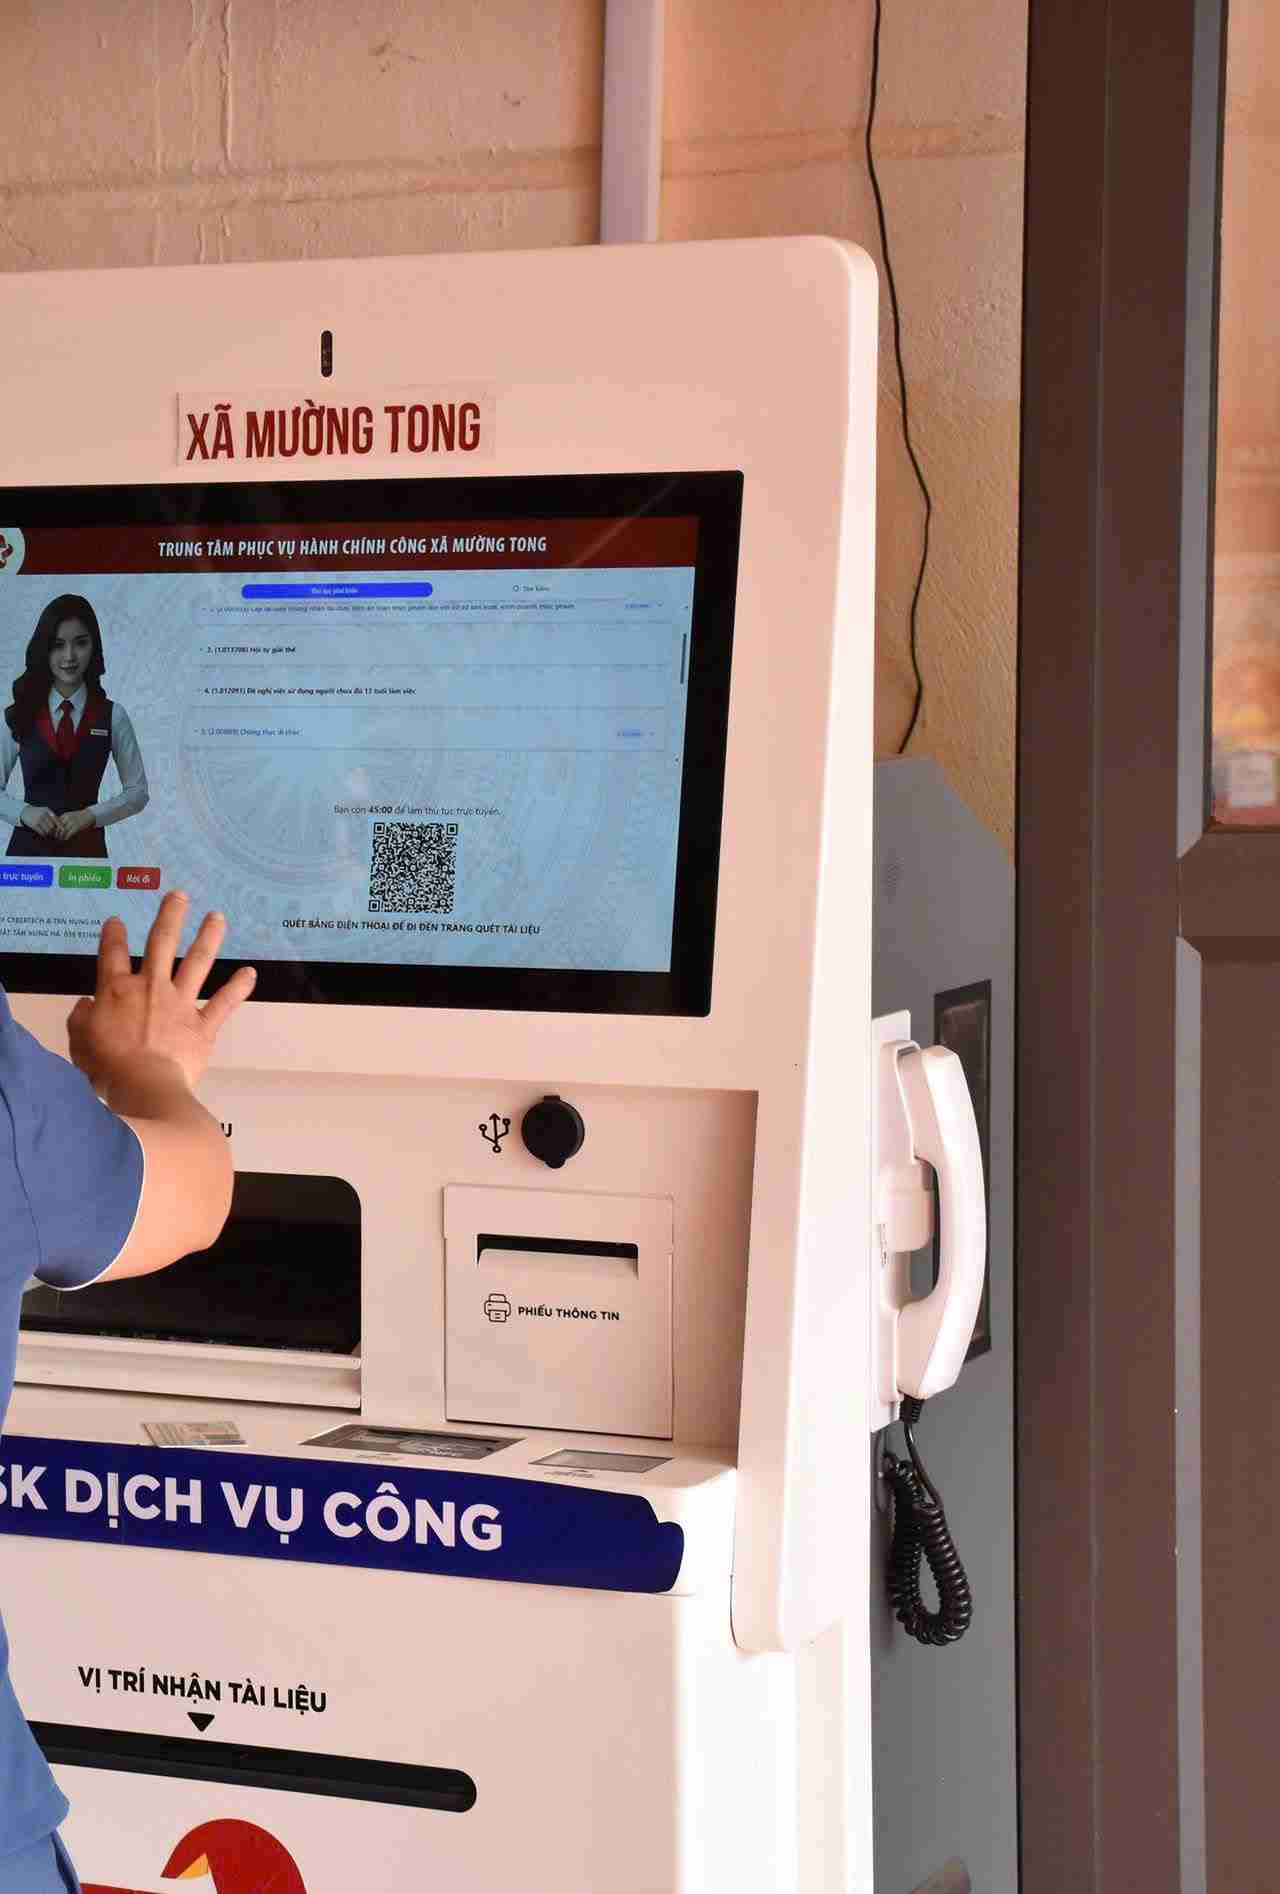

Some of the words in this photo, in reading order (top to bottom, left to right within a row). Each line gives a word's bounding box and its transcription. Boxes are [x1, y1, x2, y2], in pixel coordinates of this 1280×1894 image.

[186, 403, 235, 461] XÃ
[245, 399, 373, 459] MƯỜNG
[383, 402, 481, 454] TONG
[158, 541, 203, 557] TRUNG
[206, 539, 234, 557] TÂM
[238, 540, 274, 560] PHỤC
[278, 540, 296, 560] VỤ
[300, 537, 338, 556] HÀNH
[342, 537, 385, 555] CHÍNH
[390, 536, 427, 554] CÔNG
[430, 536, 449, 553] XÃ
[452, 535, 505, 553] MƯỜNG
[509, 536, 547, 552] TONG
[369, 806, 392, 814] 45:00
[282, 917, 306, 928] QUÉT
[441, 922, 473, 933] TRANG
[518, 1304, 552, 1317] PHIẾU
[556, 1307, 597, 1320] THÔNG
[600, 1311, 619, 1320] TIN
[65, 1468, 202, 1528] DỊCH
[220, 1481, 303, 1544] VỤ
[324, 1482, 503, 1552] CÔNG
[78, 1666, 101, 1693] VỊ
[108, 1667, 145, 1692] TRÍ
[152, 1672, 221, 1704] NHẬN
[228, 1678, 266, 1706] TÀI
[273, 1684, 327, 1715] LIỆU
